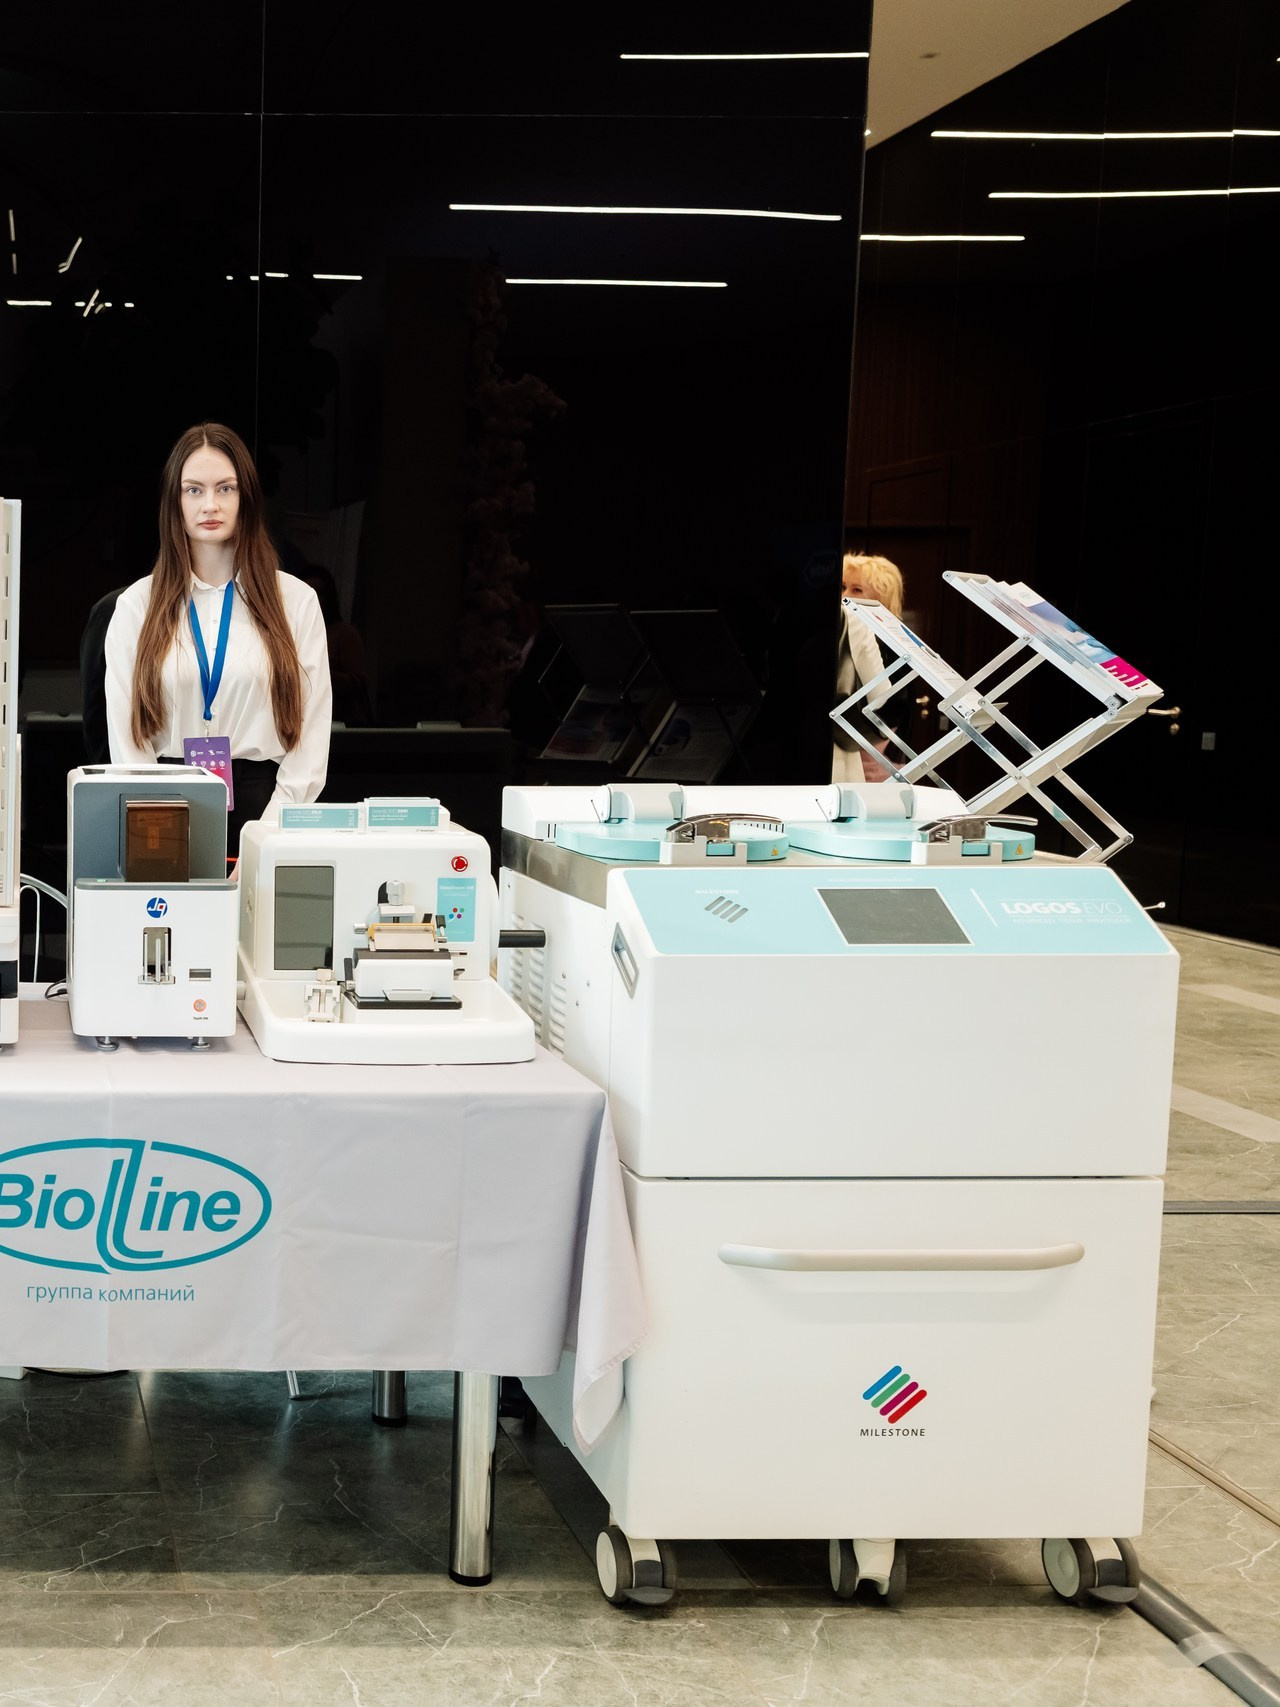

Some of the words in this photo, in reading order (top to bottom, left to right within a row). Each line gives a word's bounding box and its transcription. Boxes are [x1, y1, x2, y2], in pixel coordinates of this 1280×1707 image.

[1000, 902, 1082, 915] LOGOS
[1083, 902, 1122, 915] EVO
[26, 1285, 93, 1304] группа
[98, 1284, 195, 1303] компаний
[860, 1428, 926, 1437] MILESTONE
